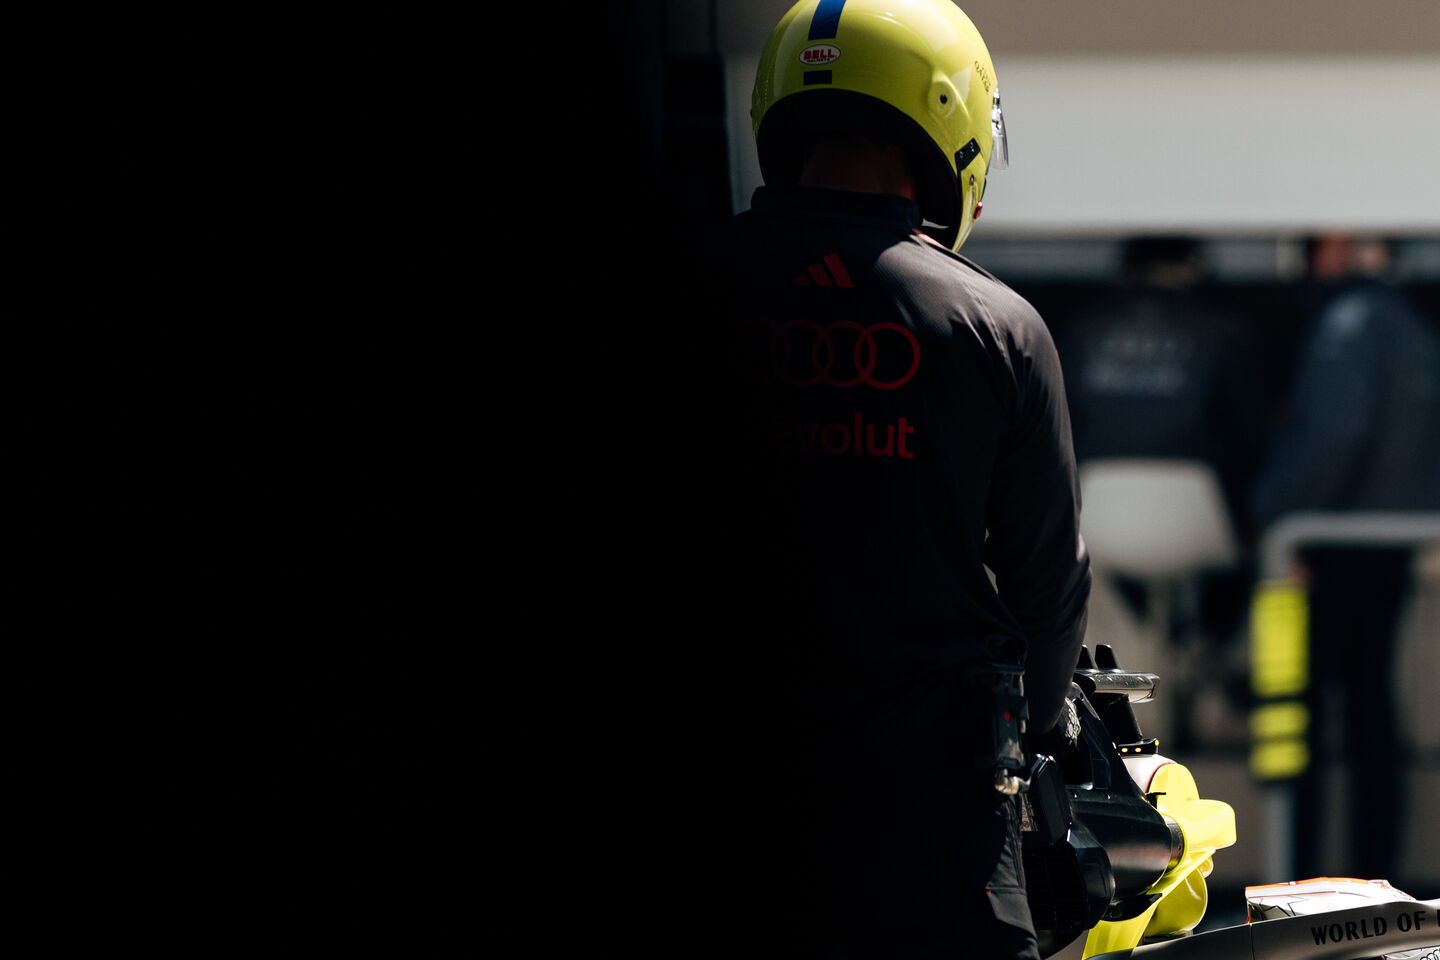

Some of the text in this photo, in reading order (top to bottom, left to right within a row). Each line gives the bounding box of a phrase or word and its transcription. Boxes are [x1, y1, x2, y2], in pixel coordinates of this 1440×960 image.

[804, 48, 834, 60] BELL
[1310, 917, 1387, 946] WORLD
[1397, 911, 1426, 932] OF
